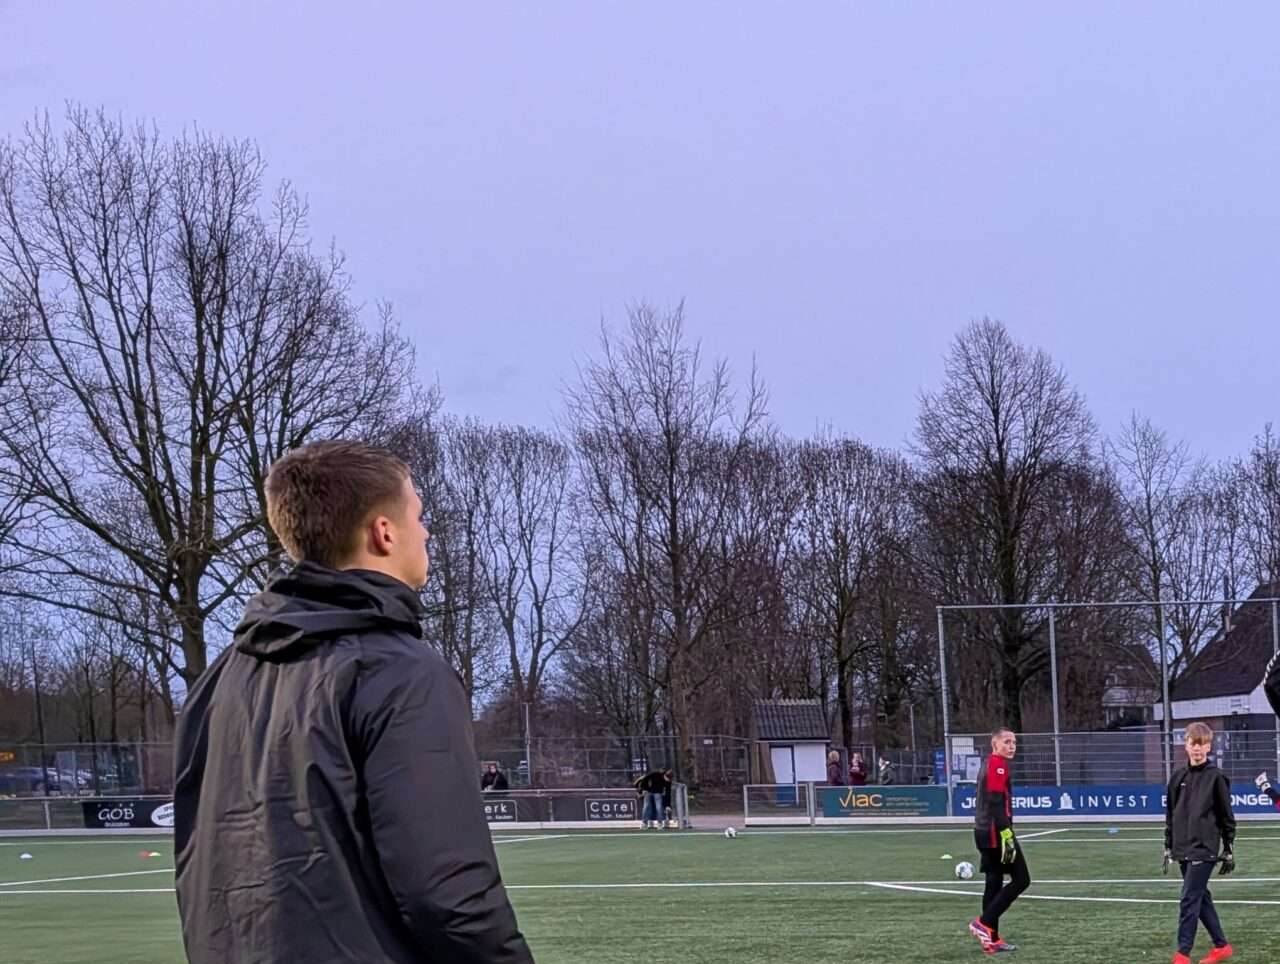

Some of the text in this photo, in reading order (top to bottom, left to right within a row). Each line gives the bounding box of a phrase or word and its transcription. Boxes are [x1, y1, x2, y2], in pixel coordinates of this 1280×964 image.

[590, 801, 634, 813] Carel
[961, 796, 1053, 809] JRIUS
[1080, 795, 1149, 808] INVEST
[484, 803, 508, 814] erk
